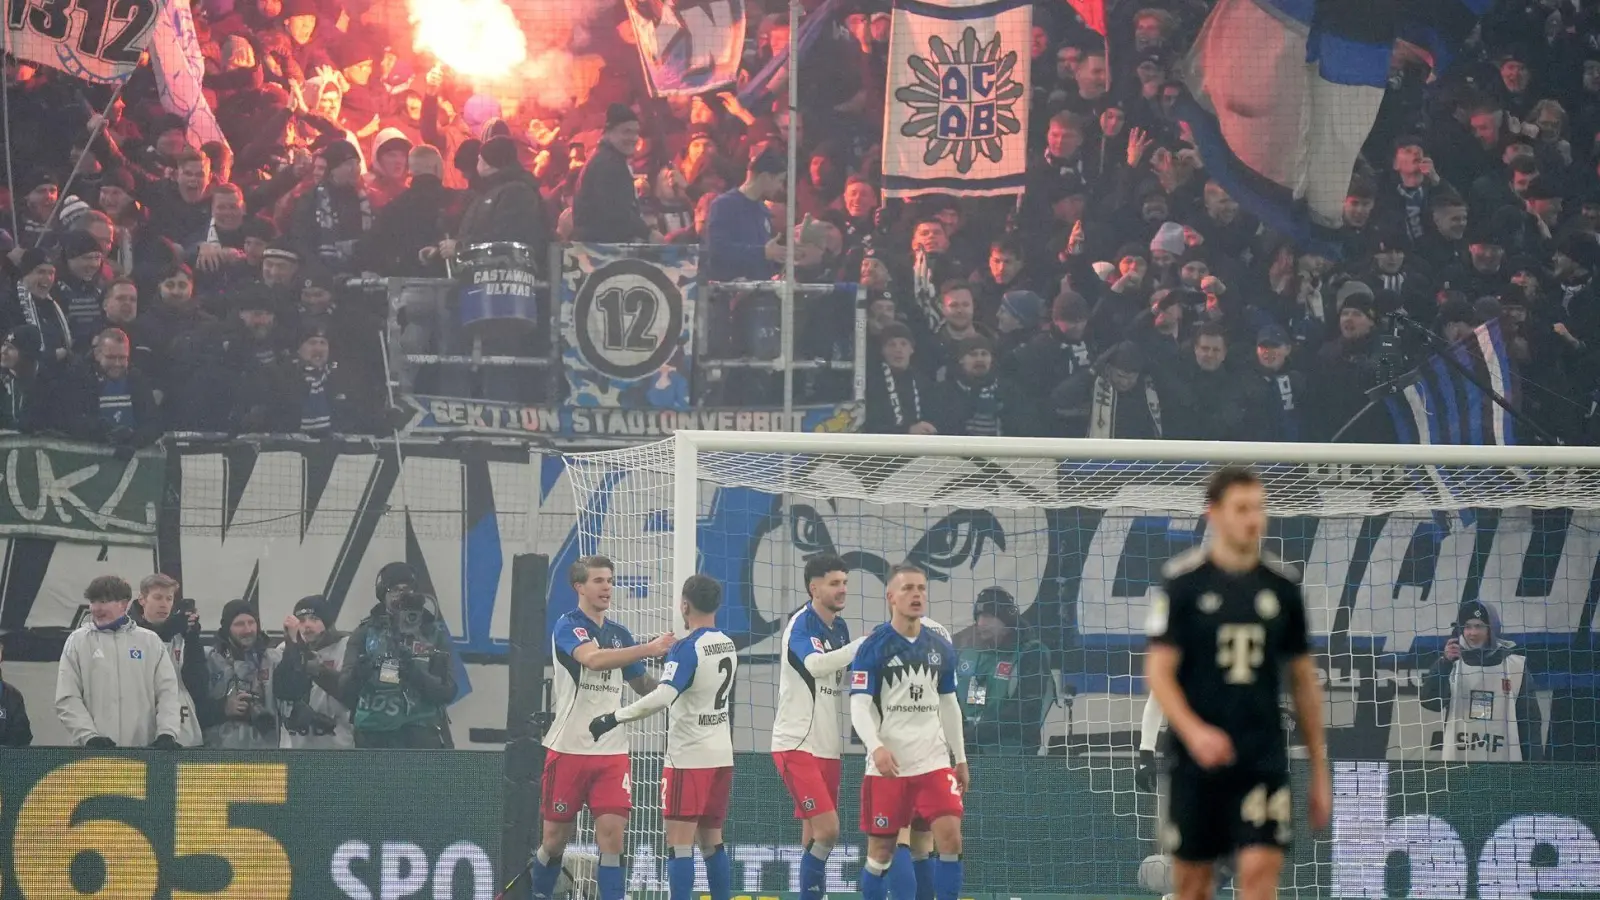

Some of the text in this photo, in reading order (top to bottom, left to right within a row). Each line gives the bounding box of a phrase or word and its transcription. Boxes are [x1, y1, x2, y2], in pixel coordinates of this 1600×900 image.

[486, 283, 531, 297] ULTRAS
[596, 286, 659, 351] 12
[430, 400, 560, 433] SEKTION
[714, 656, 733, 710] 2
[1456, 731, 1505, 753] SMF
